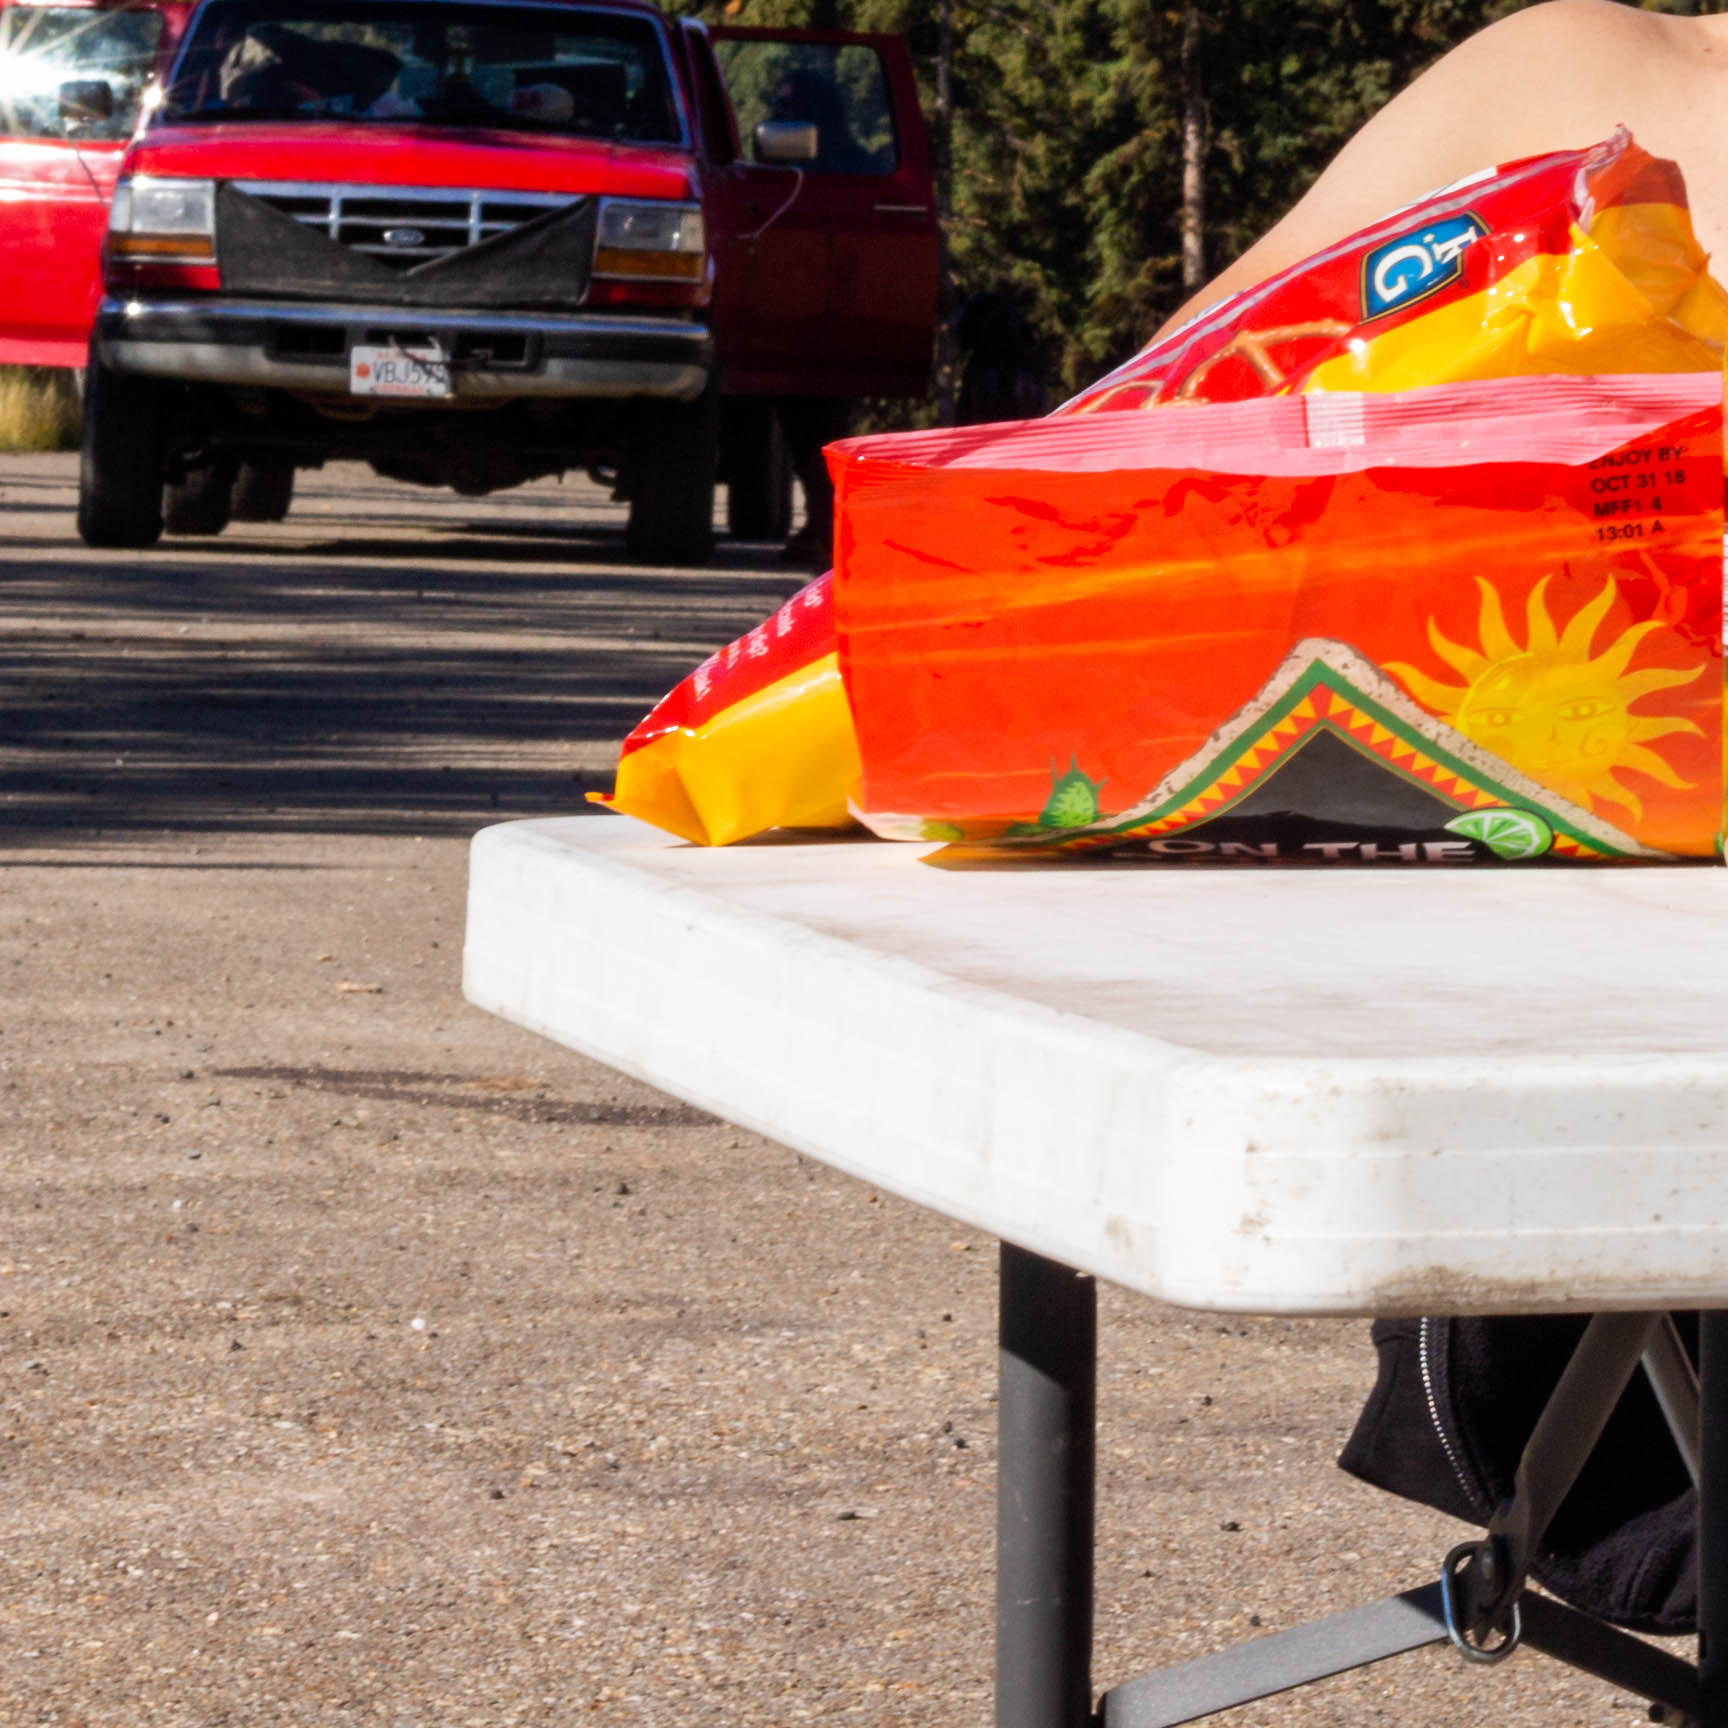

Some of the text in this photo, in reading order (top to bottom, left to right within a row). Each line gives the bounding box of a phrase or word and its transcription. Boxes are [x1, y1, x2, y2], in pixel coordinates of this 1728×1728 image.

[1657, 446, 1684, 462] BY
[1590, 469, 1686, 494] OCT 31 18
[1651, 519, 1664, 534] A
[1147, 838, 1476, 862] ON THE
